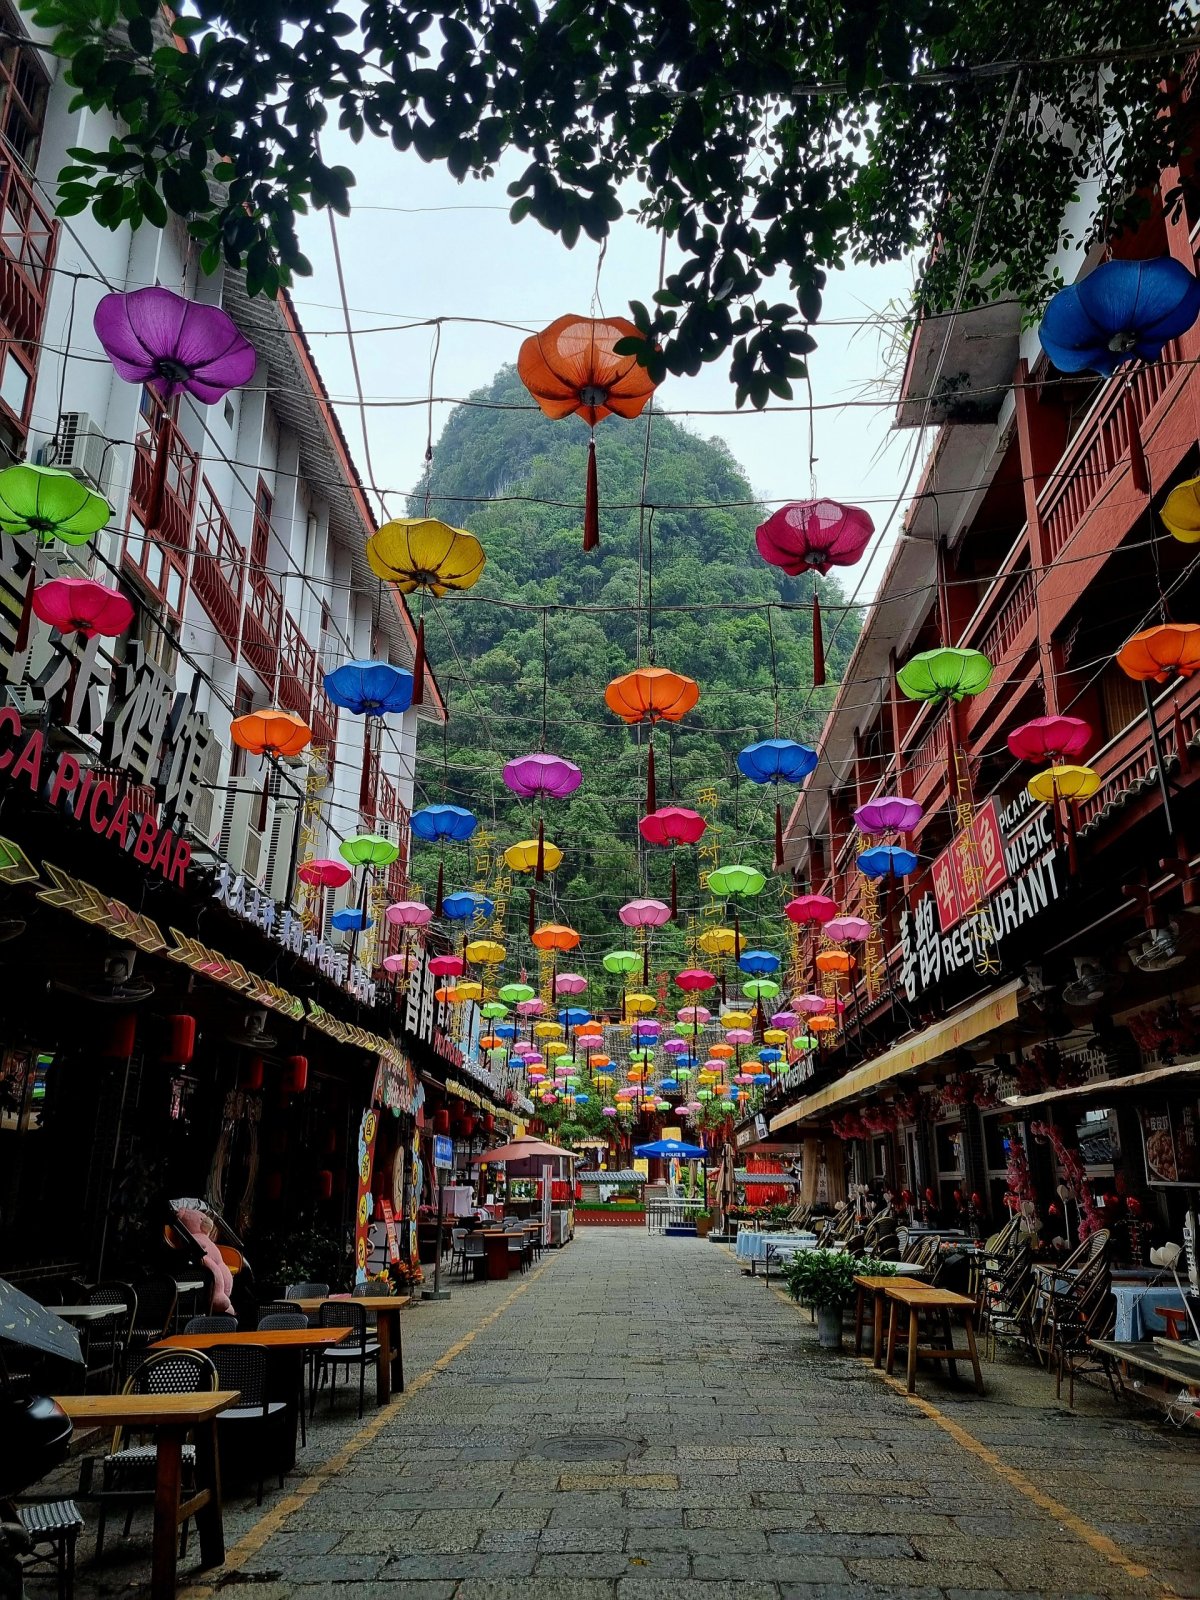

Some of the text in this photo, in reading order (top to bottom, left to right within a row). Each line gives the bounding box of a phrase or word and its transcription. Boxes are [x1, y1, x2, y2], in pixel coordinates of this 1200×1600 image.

[50, 752, 133, 851] PICA
[133, 813, 191, 888] BAR
[934, 814, 1002, 920] 啤酒鱼
[999, 804, 1021, 834] PICA
[1004, 809, 1053, 877] MUSIC
[941, 849, 1060, 976] RESTAURANT
